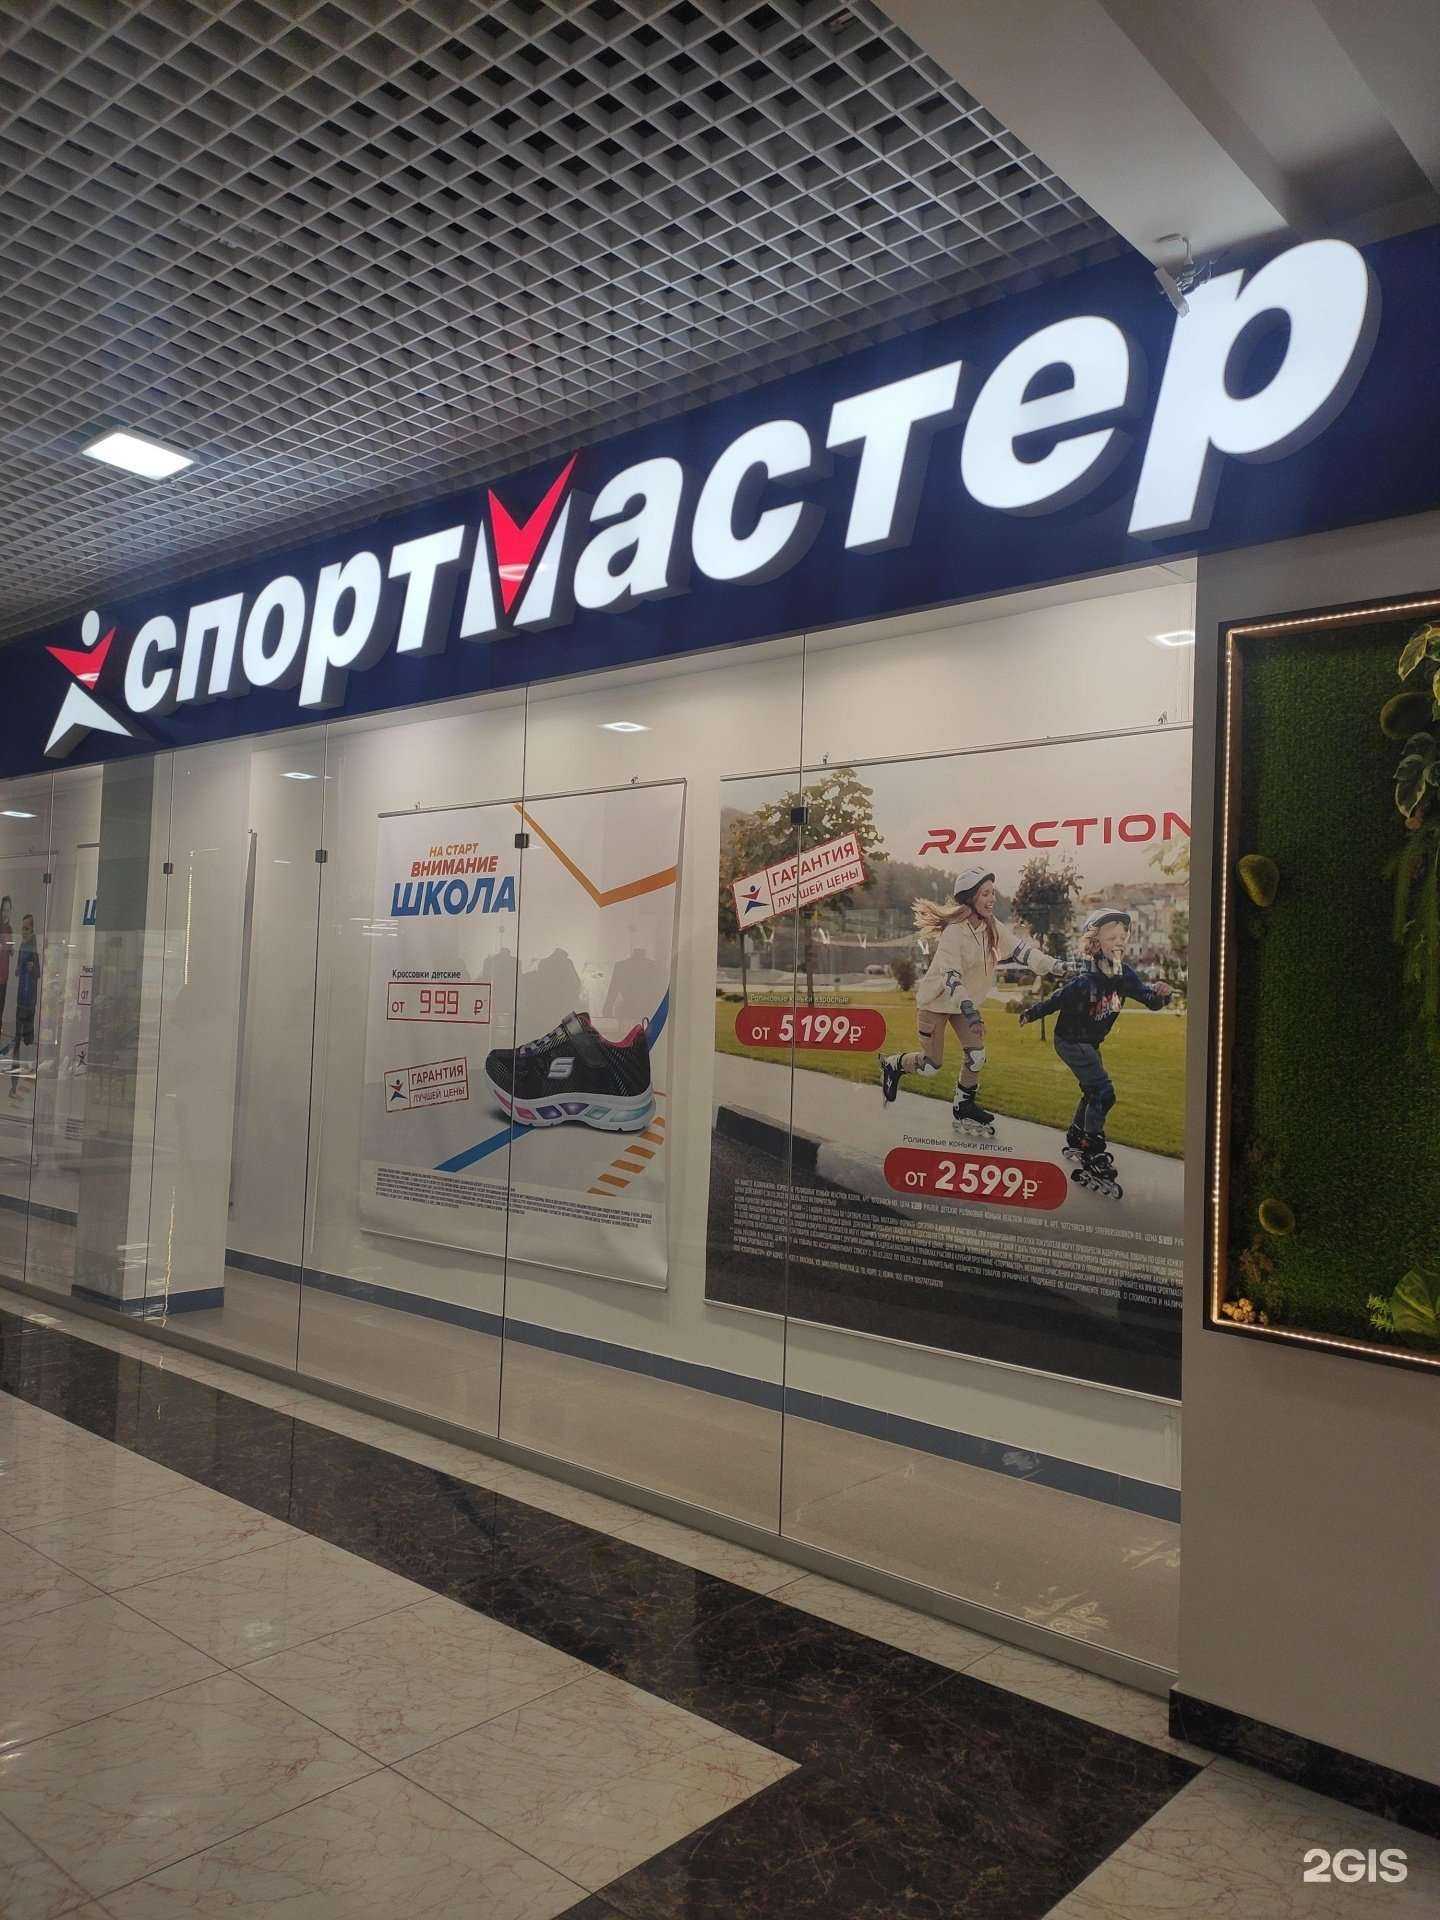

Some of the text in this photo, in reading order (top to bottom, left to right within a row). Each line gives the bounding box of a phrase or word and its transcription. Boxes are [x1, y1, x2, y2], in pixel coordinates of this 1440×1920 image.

[429, 842, 479, 857] НА СТАРТ
[411, 856, 498, 877] ВНИМАНИЕ
[772, 842, 855, 886] ГАРАНТИЯ
[826, 868, 859, 889] ЦЕНЫ
[391, 876, 516, 916] ШКОЛА
[392, 969, 430, 980] Кроссовки
[420, 990, 459, 1015] 999
[412, 1064, 464, 1085] ГАРАНТИЯ
[443, 1086, 465, 1098] ЦЕНЫ
[903, 1134, 948, 1147] Роликовые
[948, 1140, 978, 1150] коньки
